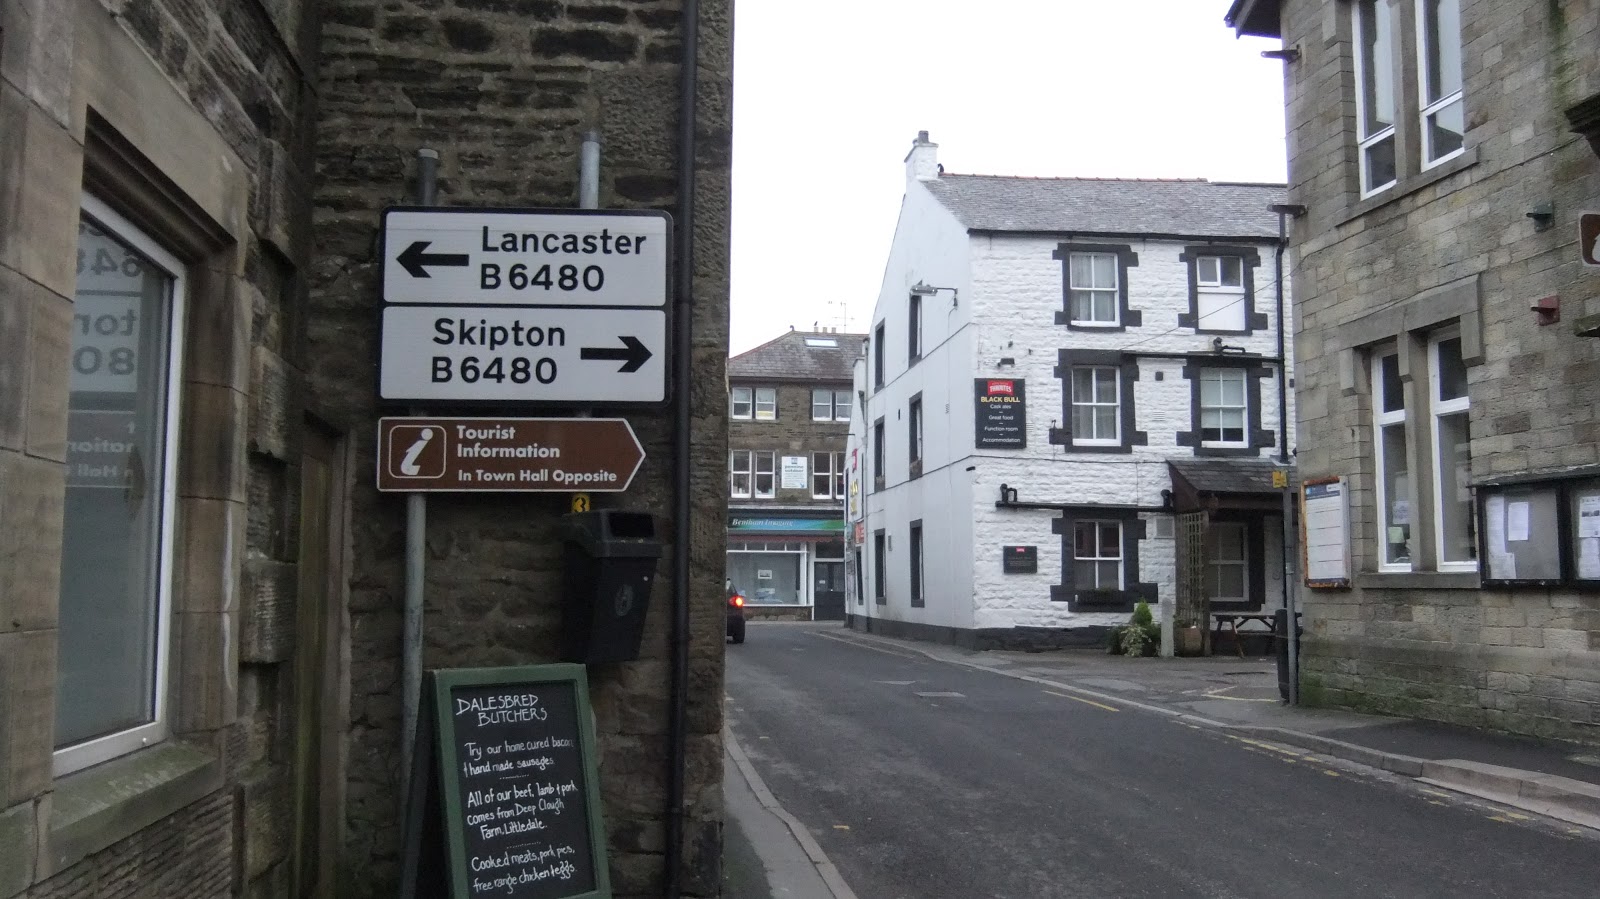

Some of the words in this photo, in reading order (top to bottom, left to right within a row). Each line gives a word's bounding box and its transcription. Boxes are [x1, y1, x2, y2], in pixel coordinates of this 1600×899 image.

[482, 226, 647, 255] Lancaster
[480, 264, 605, 291] B6480
[432, 318, 565, 350] Skipton
[431, 357, 558, 384] B6480
[457, 425, 515, 440] Tourist
[457, 444, 560, 458] Information
[458, 470, 472, 481] In
[476, 470, 515, 481] Town
[520, 469, 548, 482] Hall
[552, 470, 617, 484] Opposite
[456, 694, 539, 716] DALESBRED
[478, 708, 548, 726] BUTCHERS
[464, 742, 482, 760] Try
[487, 745, 502, 755] our
[505, 740, 525, 753] home
[527, 737, 550, 750] cured
[551, 736, 573, 747] bacon
[470, 762, 491, 775] hand
[492, 760, 514, 772] made
[468, 790, 483, 808] All
[484, 788, 495, 803] of
[497, 787, 512, 801] our
[536, 782, 555, 796] lamb
[562, 780, 578, 795] pork
[467, 812, 495, 826] comes
[497, 807, 515, 820] from
[515, 803, 536, 816] Deep
[538, 798, 565, 815] Clough
[471, 852, 510, 872] Cooked
[540, 846, 554, 864] pork
[473, 877, 493, 893] free
[494, 872, 517, 894] range
[519, 868, 550, 884] chicken
